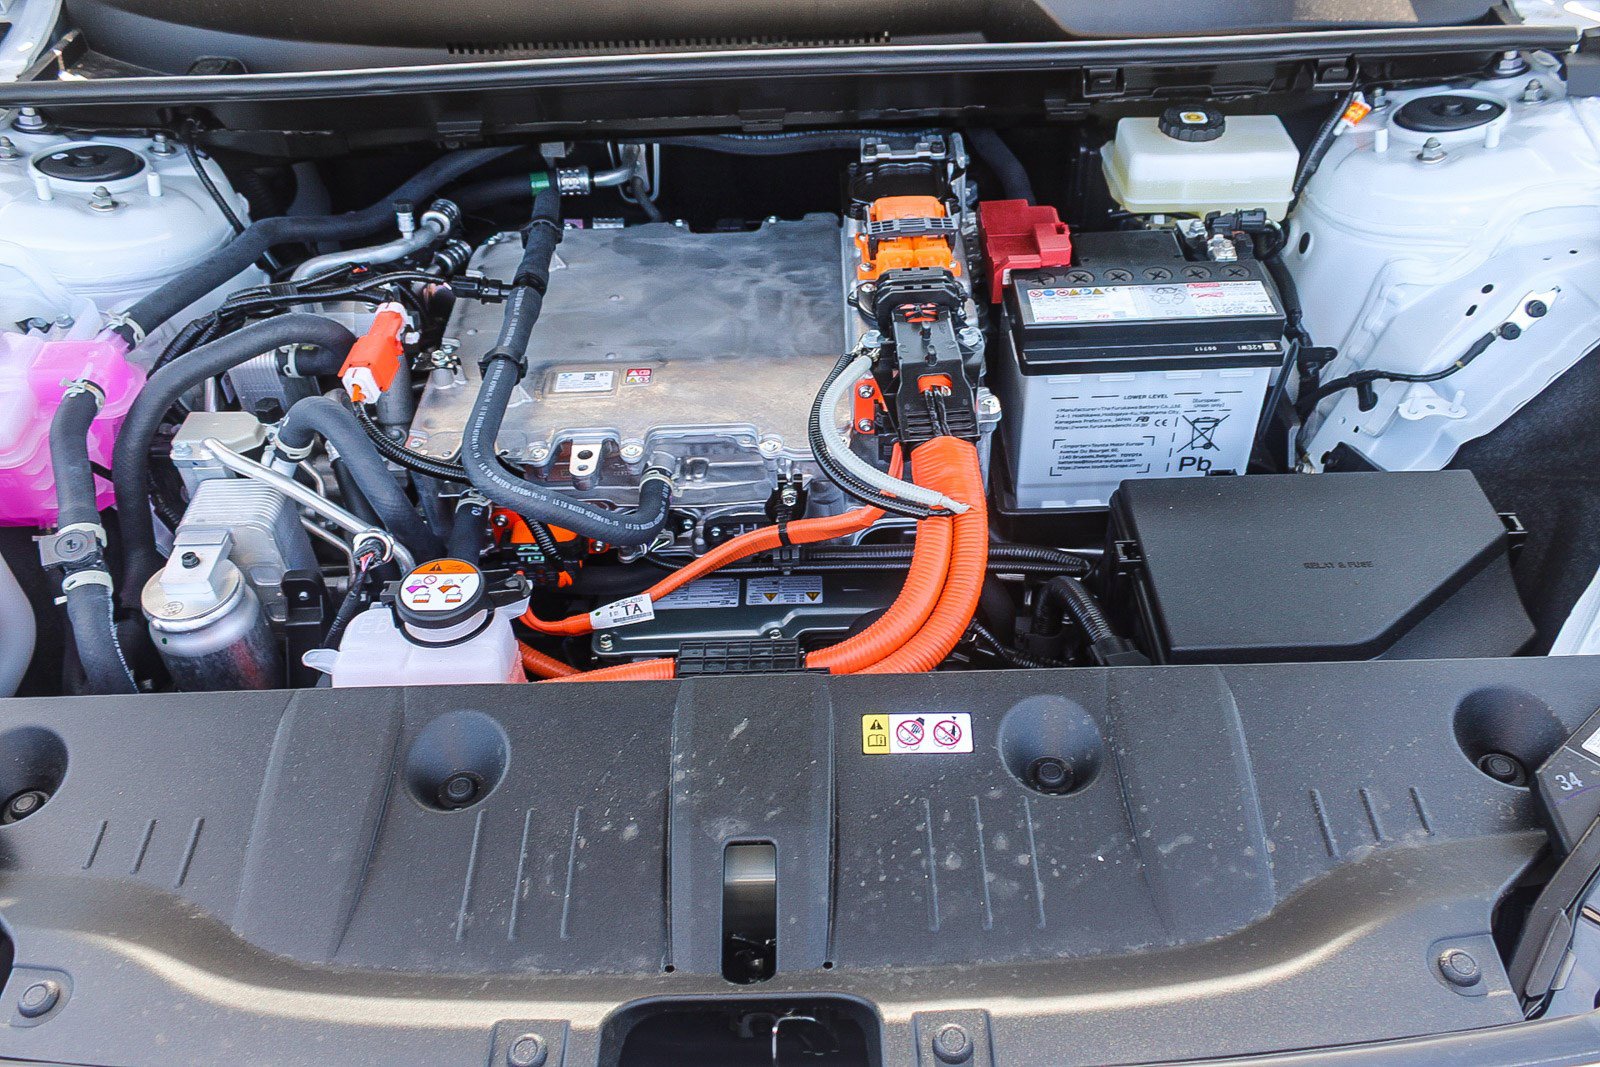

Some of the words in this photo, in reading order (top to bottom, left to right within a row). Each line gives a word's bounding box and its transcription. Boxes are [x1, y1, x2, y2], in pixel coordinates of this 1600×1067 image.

[1154, 419, 1168, 427] CE
[1178, 456, 1212, 472] Pb
[621, 603, 643, 616] TA
[1555, 771, 1583, 790] 34
